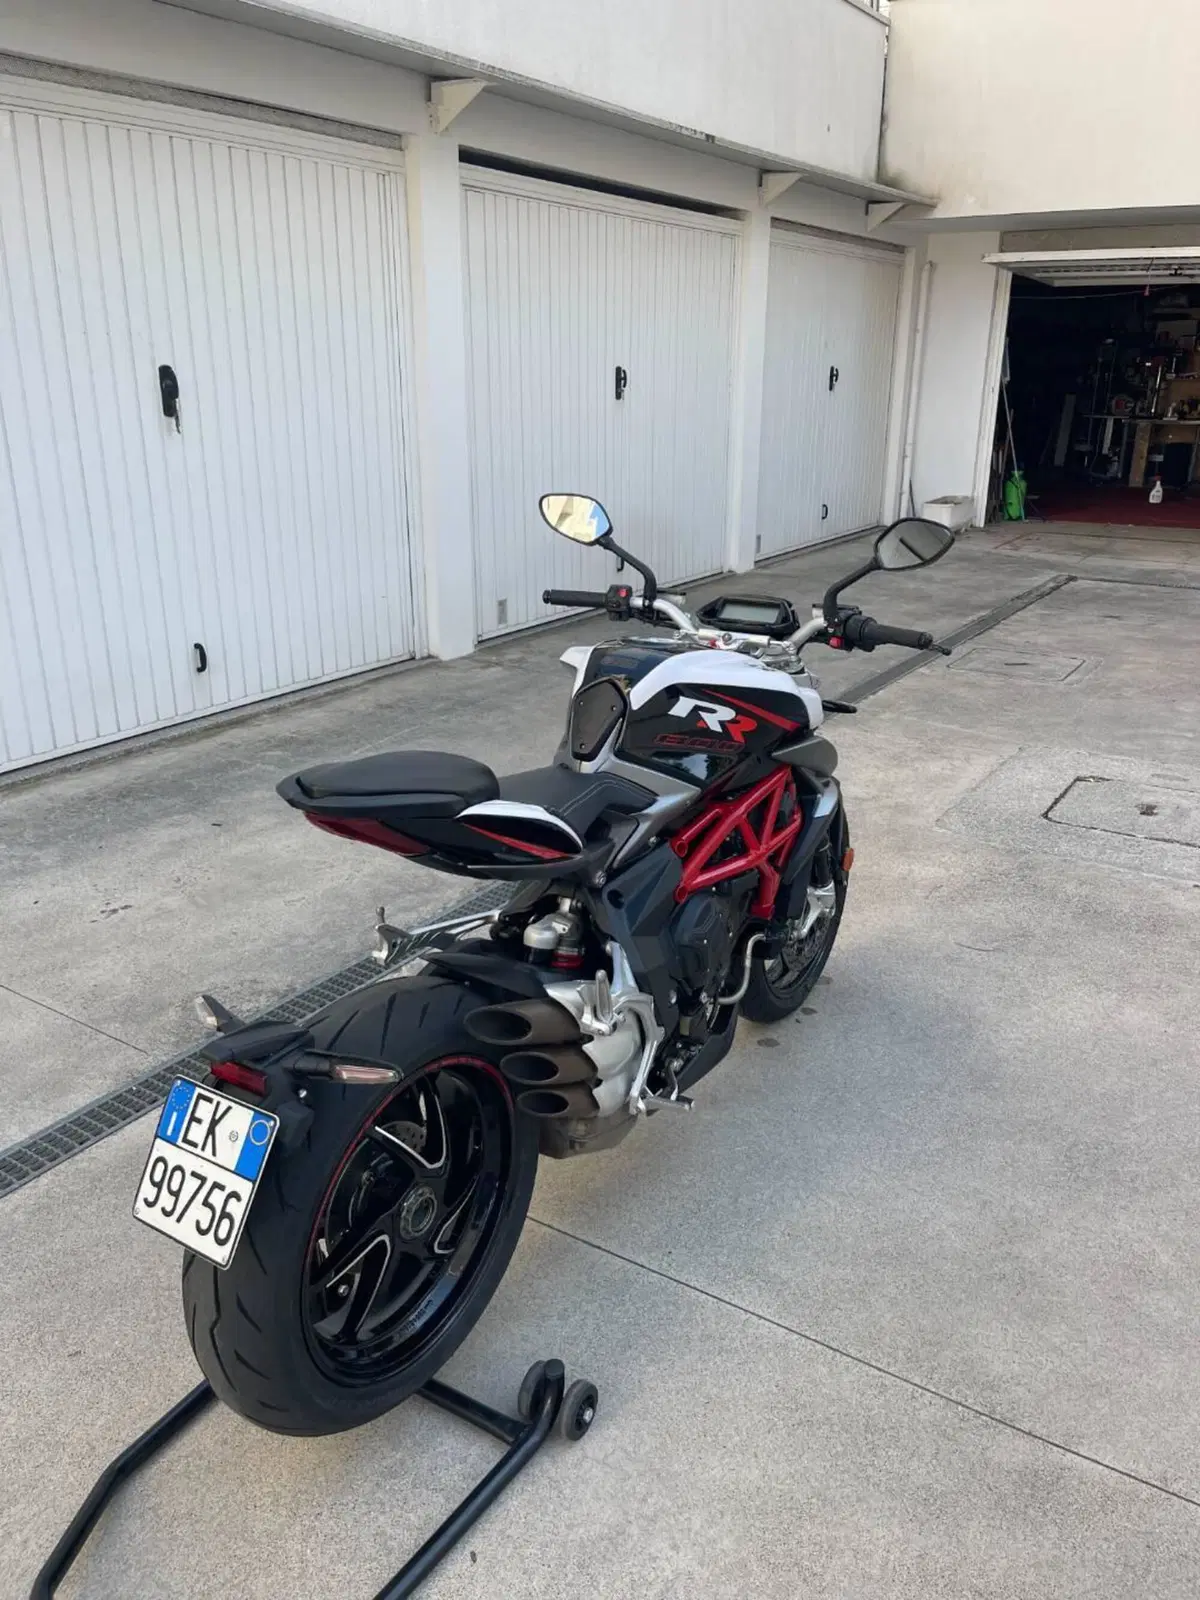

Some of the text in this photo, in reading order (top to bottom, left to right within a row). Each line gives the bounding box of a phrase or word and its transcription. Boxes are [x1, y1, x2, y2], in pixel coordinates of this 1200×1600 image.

[166, 1092, 233, 1157] I EK
[143, 1156, 242, 1246] 99756
